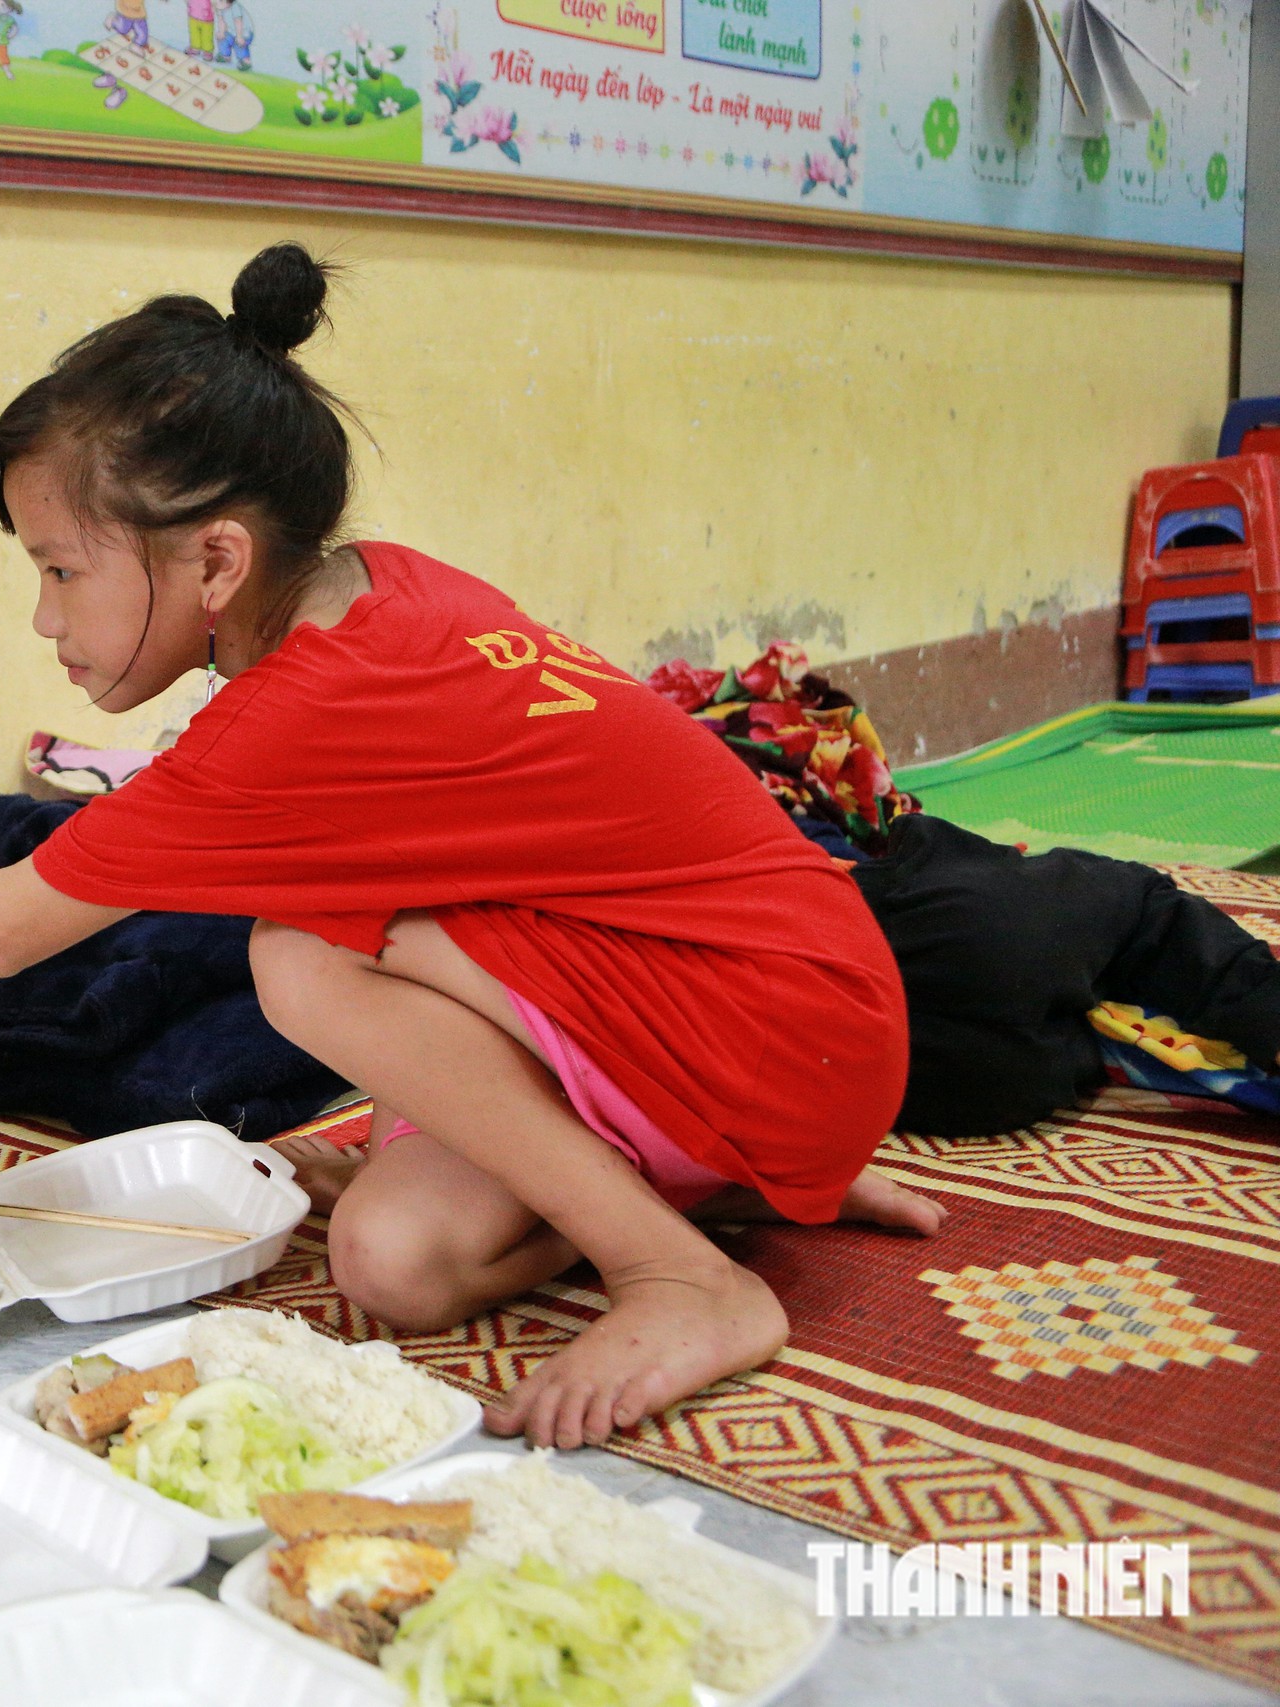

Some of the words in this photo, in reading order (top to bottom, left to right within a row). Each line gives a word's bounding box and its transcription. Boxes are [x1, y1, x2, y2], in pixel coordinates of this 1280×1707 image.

[762, 37, 807, 68] mạnh
[540, 63, 589, 101] ngày
[637, 73, 665, 110] lớp
[689, 82, 713, 113] Là
[755, 98, 793, 133] ngày
[798, 105, 823, 131] vui
